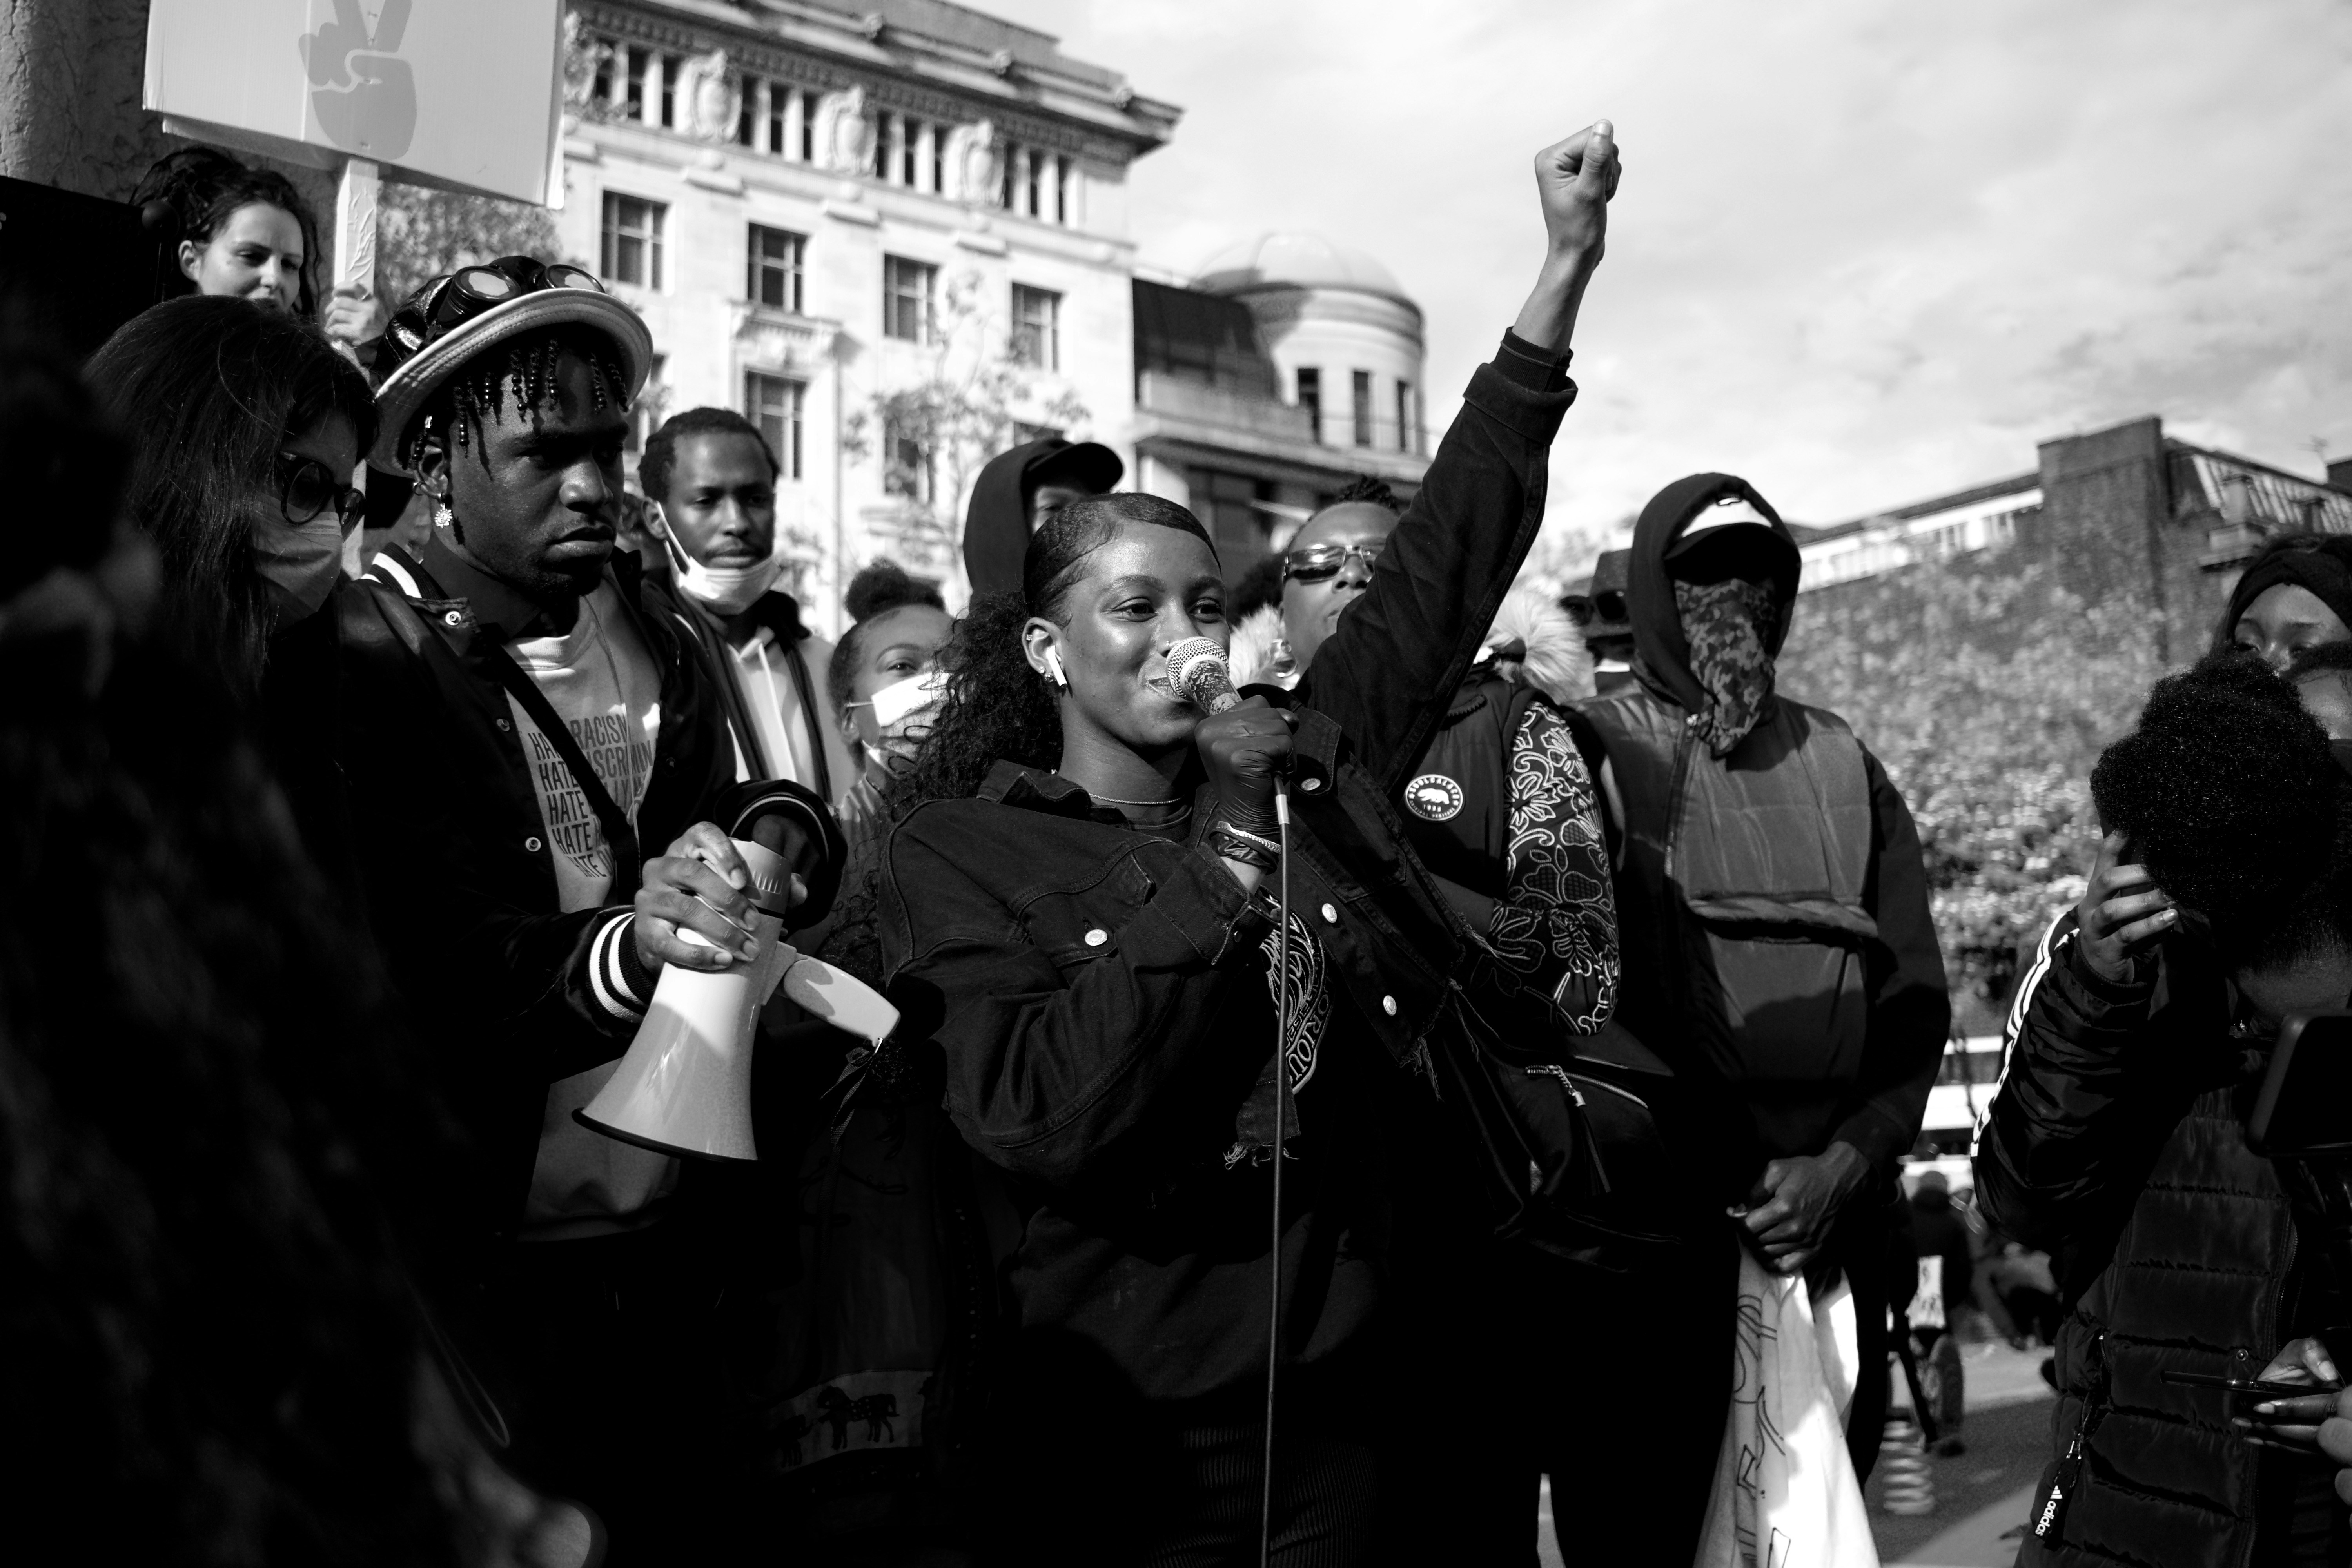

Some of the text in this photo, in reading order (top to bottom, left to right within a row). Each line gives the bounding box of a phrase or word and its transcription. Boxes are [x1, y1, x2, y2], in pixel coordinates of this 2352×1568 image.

[528, 733, 560, 760] HA
[547, 790, 588, 825] HATE
[552, 822, 593, 855] HATE
[2035, 1500, 2057, 1536] adidas
